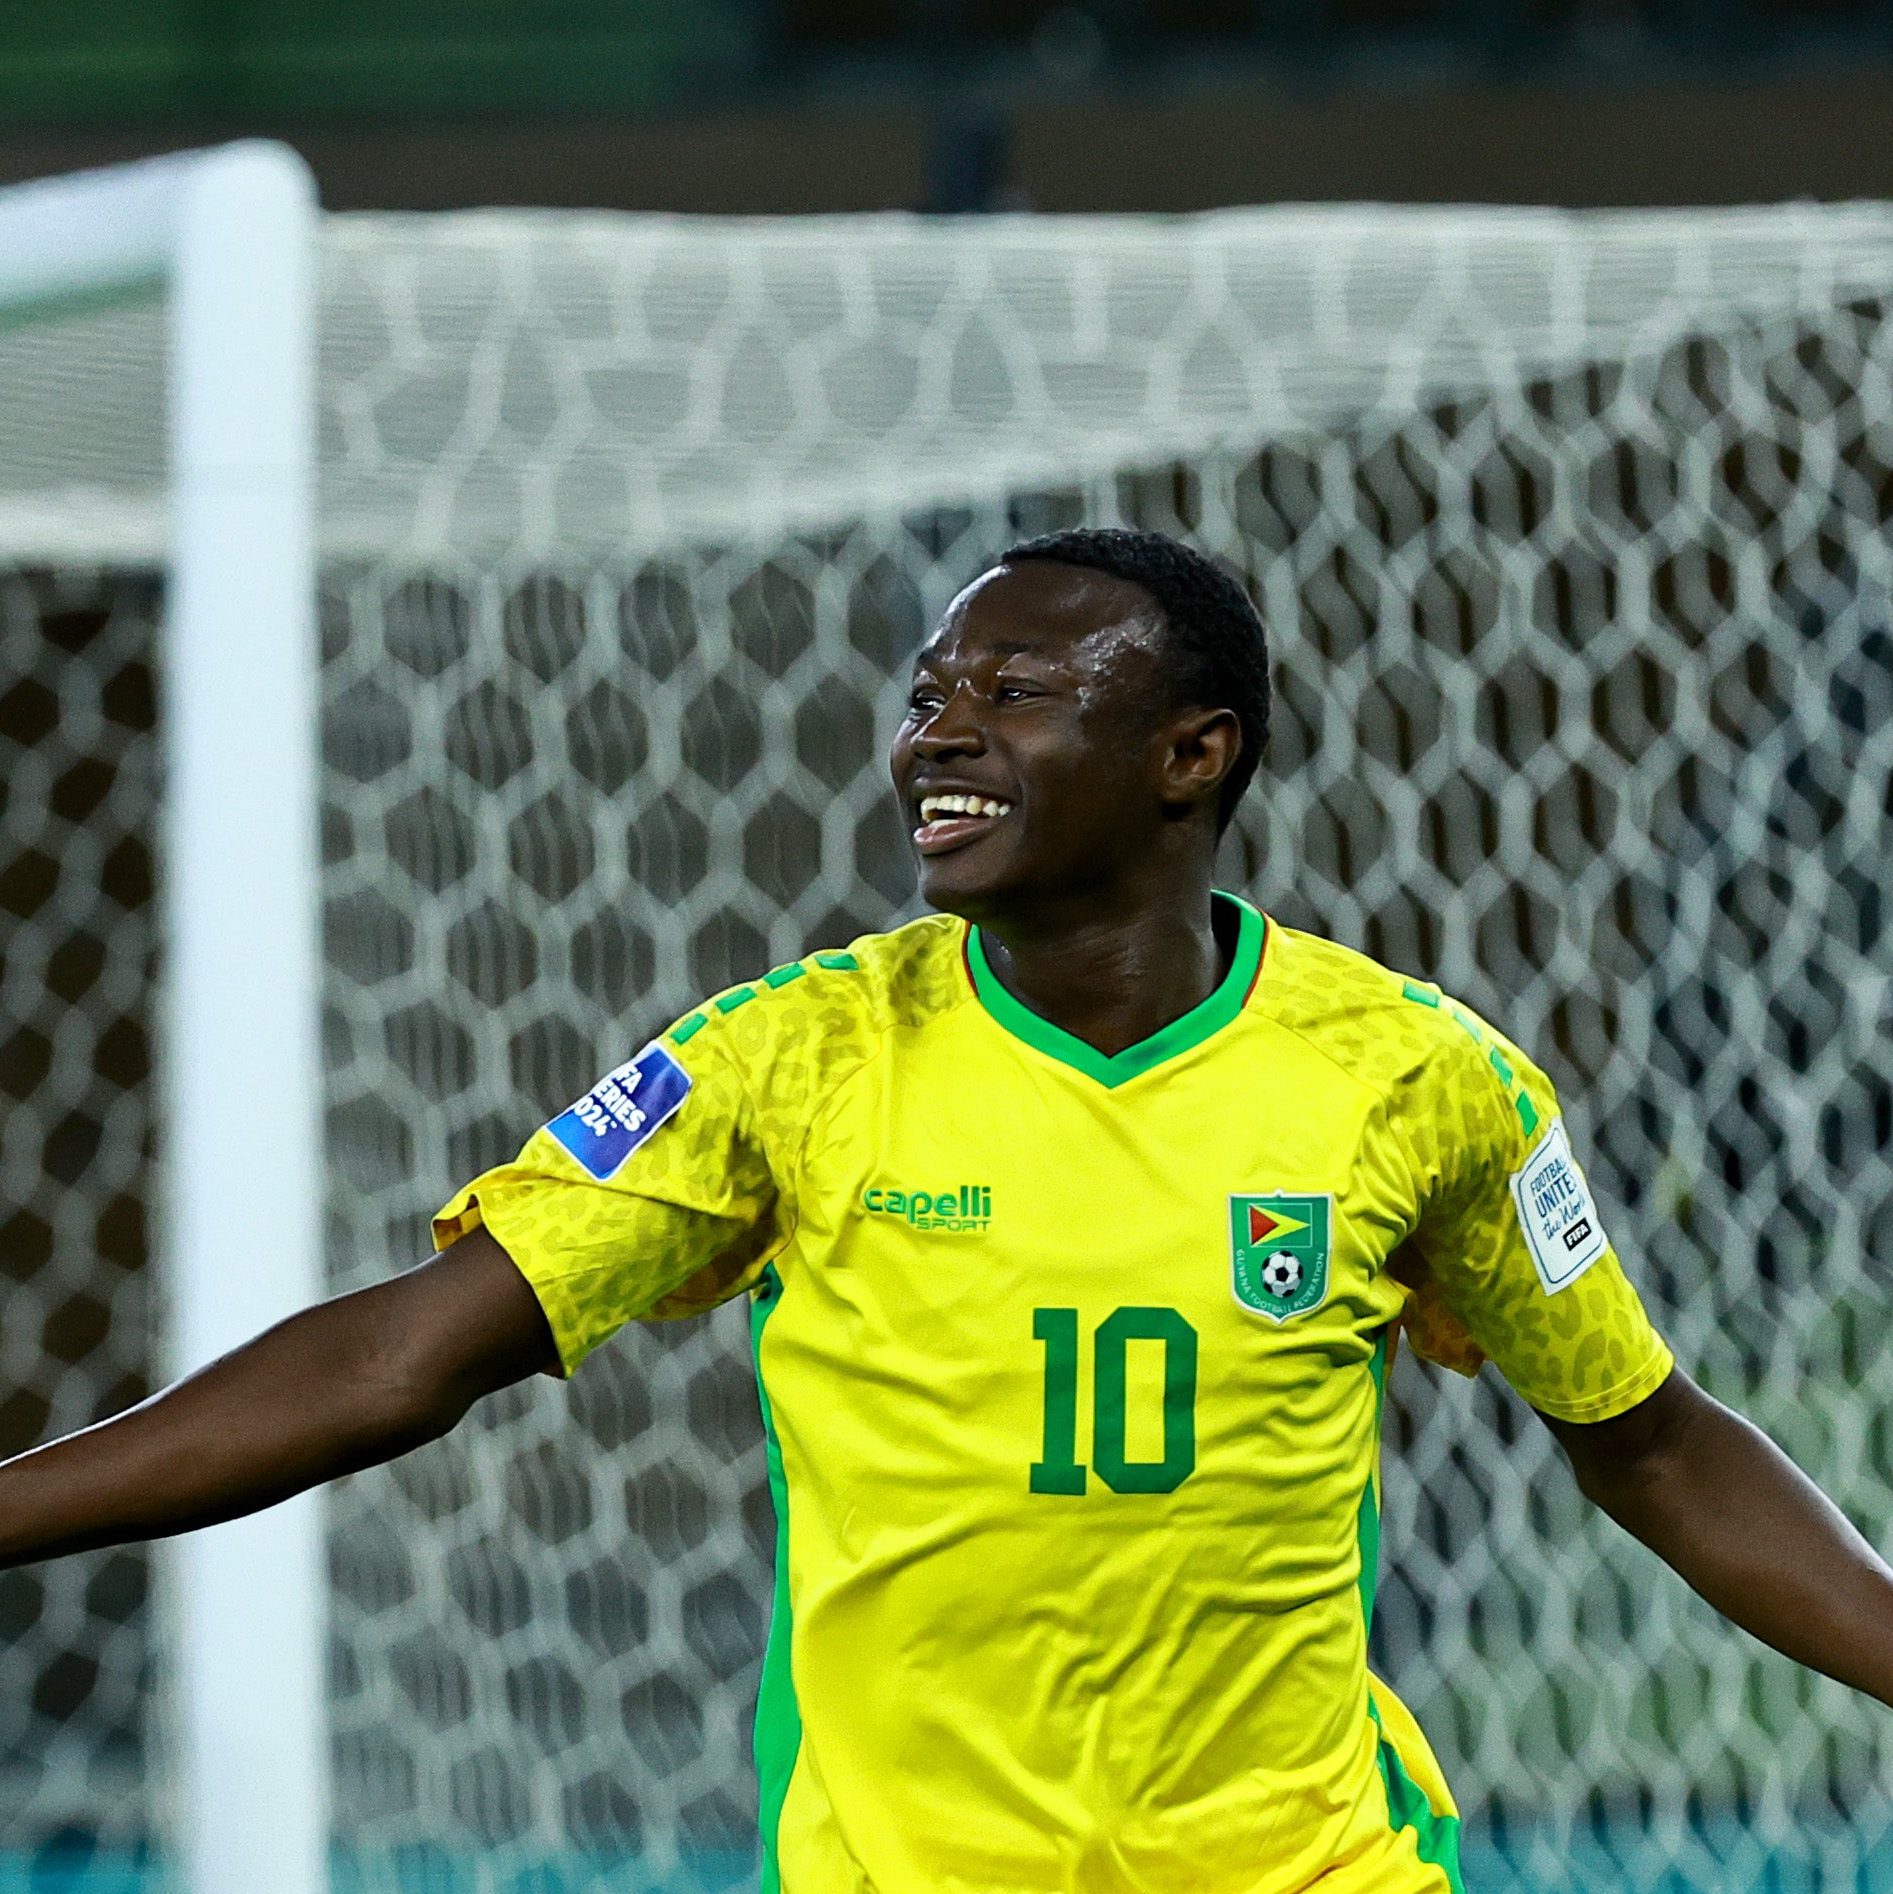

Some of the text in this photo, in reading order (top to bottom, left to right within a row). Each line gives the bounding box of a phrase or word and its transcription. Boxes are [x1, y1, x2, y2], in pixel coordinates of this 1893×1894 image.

[574, 1096, 612, 1137] 024
[592, 1080, 647, 1132] ERIES
[1530, 1157, 1567, 1198] FOOTBA
[864, 1185, 991, 1224] capelli
[916, 1217, 991, 1232] SPORT
[1565, 1223, 1589, 1246] FIFA
[1236, 1248, 1253, 1294] GUYANA
[1029, 1306, 1198, 1496] 10
